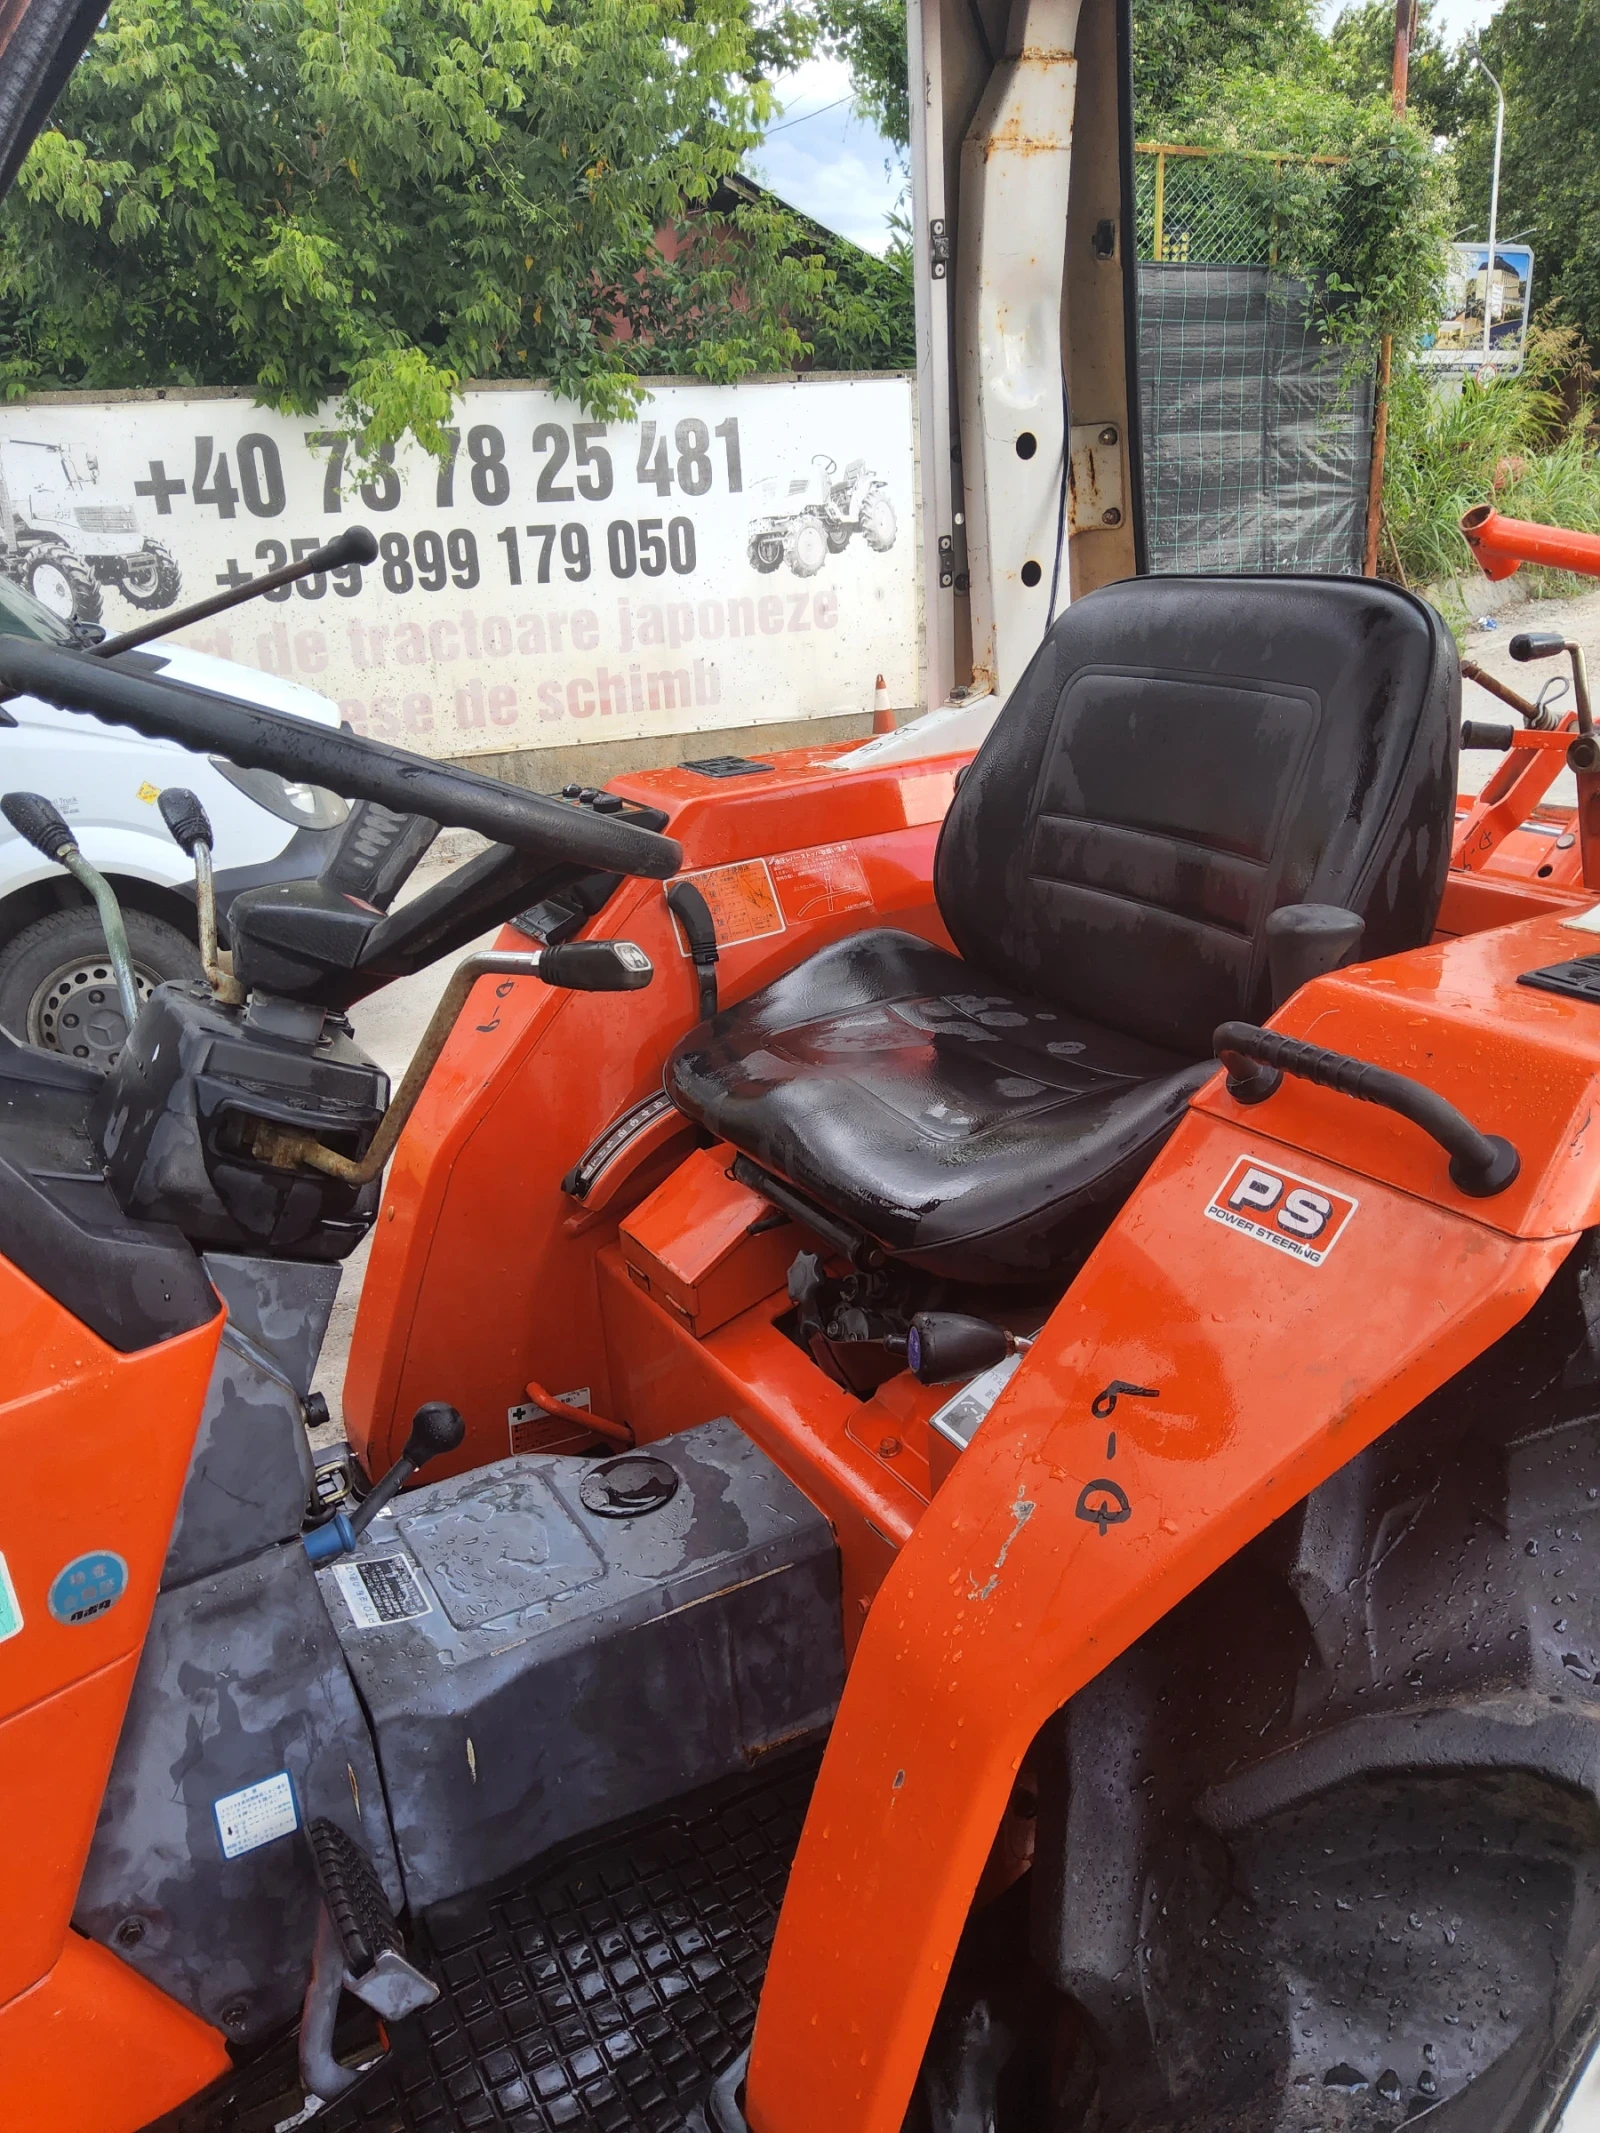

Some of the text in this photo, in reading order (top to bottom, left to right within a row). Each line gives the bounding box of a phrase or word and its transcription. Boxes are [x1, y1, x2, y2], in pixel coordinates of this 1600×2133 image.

[134, 417, 743, 519] +40 73 78 25 481
[379, 527, 481, 594] 899
[497, 522, 591, 586] 179
[608, 516, 697, 580] 050
[256, 620, 330, 675] de
[347, 606, 600, 669] tractoare
[617, 589, 839, 654] japoneze
[338, 658, 722, 738] ese de schimb
[1207, 1205, 1322, 1263] POWER STEERING
[1228, 1166, 1333, 1240] PS
